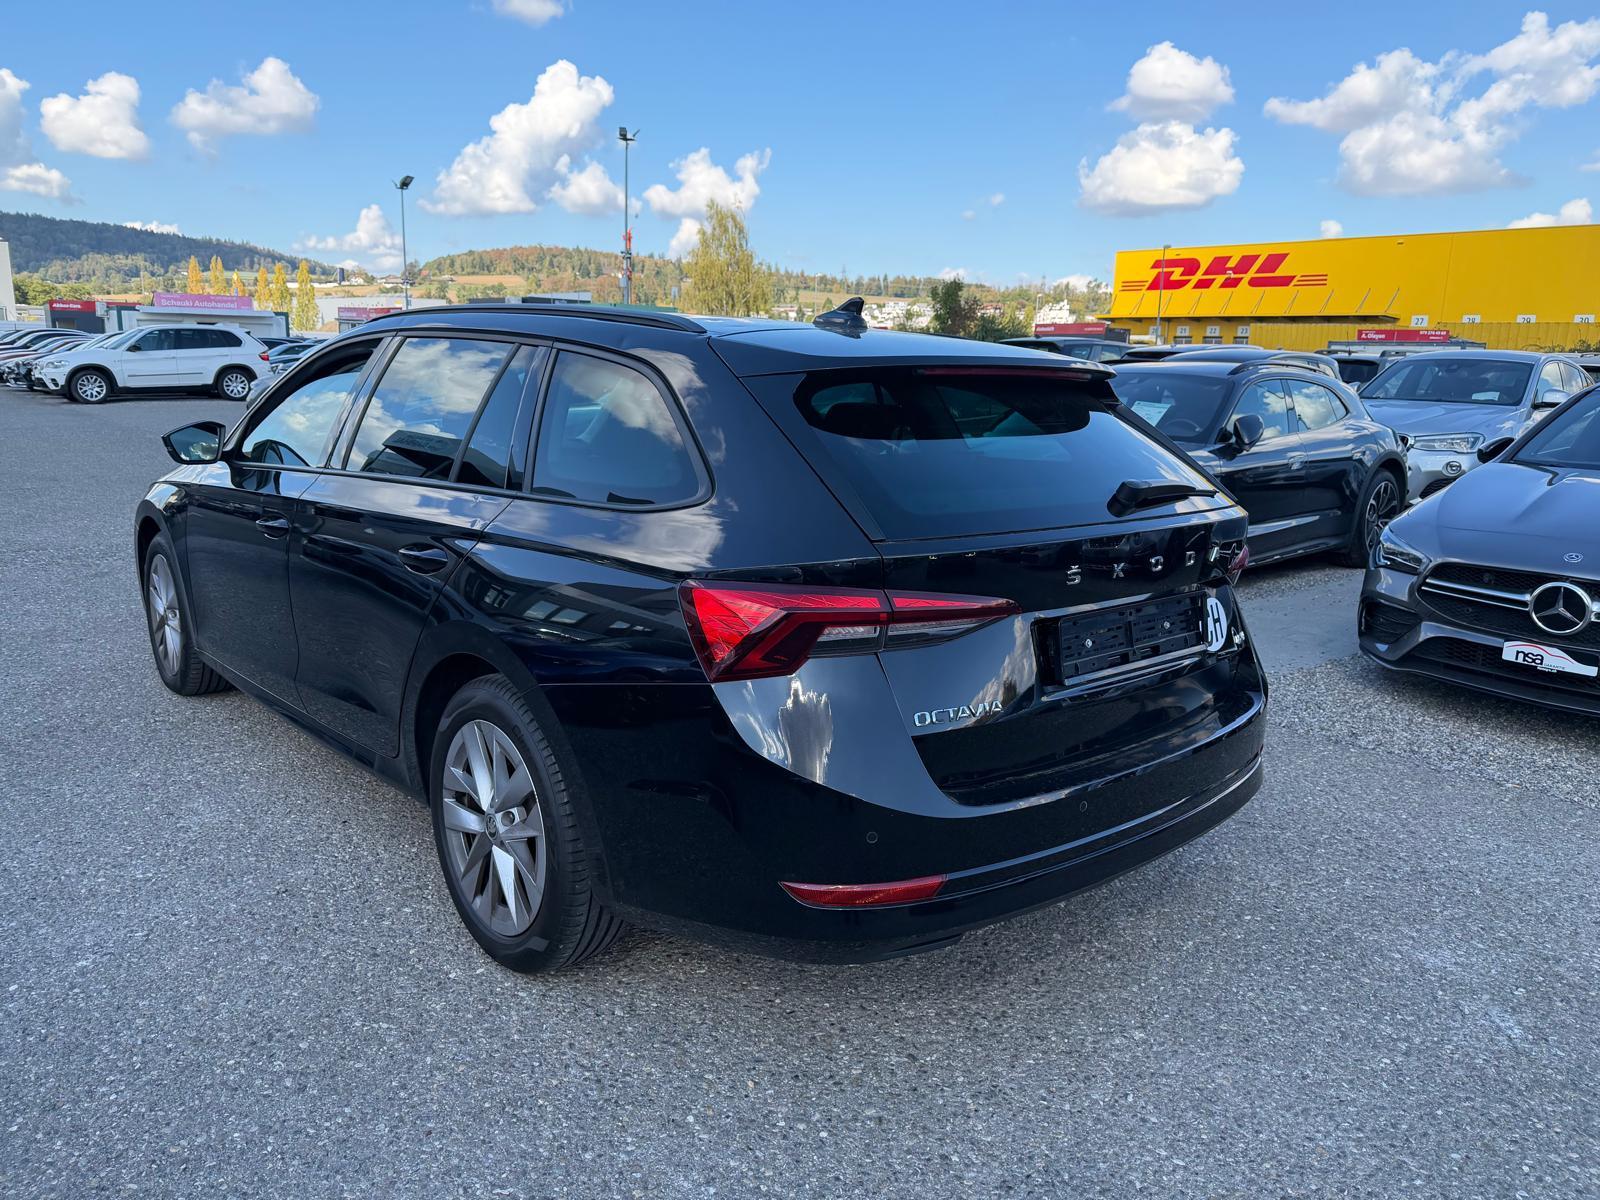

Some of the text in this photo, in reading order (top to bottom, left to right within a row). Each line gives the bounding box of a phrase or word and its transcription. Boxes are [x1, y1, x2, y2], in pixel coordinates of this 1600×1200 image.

[1146, 252, 1297, 291] DHL
[194, 300, 238, 309] Autohandel
[1415, 317, 1425, 326] 27
[1208, 327, 1217, 335] 22
[1515, 649, 1544, 666] nsa
[913, 700, 1004, 727] OCTAVIA
